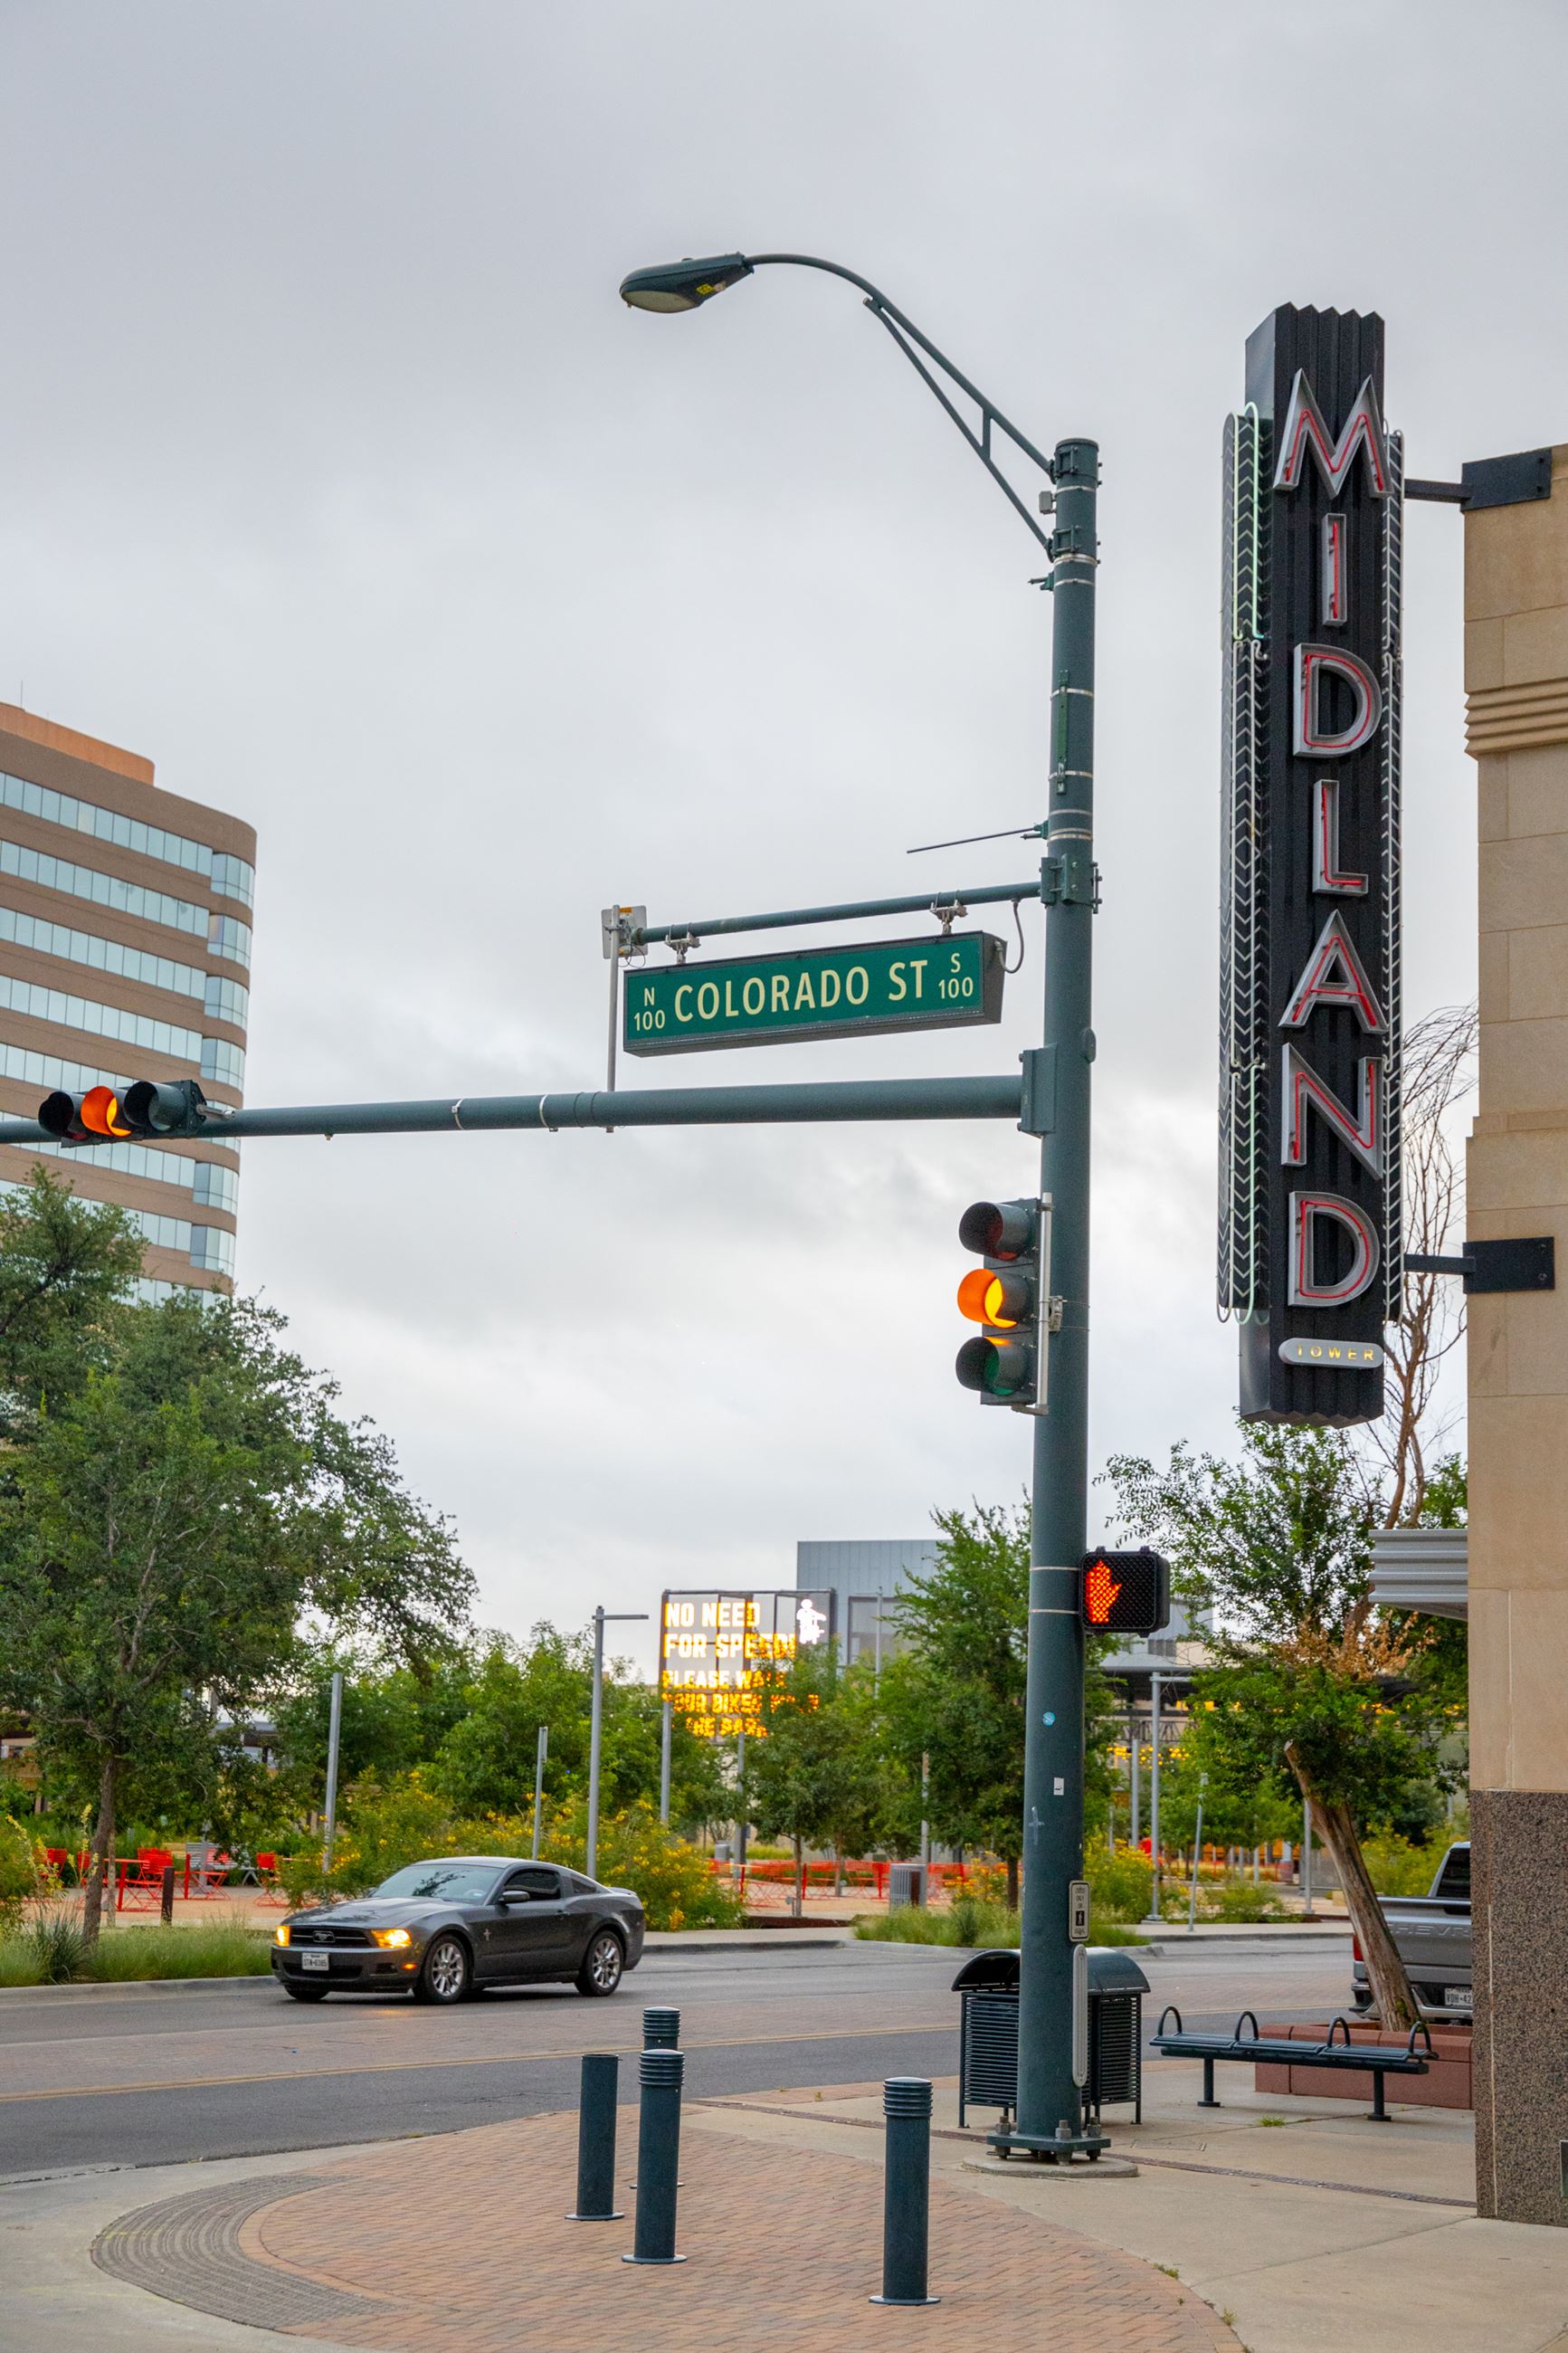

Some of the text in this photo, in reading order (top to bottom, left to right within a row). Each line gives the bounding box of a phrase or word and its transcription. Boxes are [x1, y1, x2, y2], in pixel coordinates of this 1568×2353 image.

[1273, 367, 1394, 1308] MIDLAND
[950, 952, 961, 974] S
[643, 986, 655, 1007] N
[674, 959, 928, 1023] COLORADO ST
[938, 976, 974, 1000] 100
[633, 1009, 666, 1032] 100
[1296, 1344, 1374, 1362] TOWER
[665, 1602, 761, 1628] NO NEED
[663, 1633, 708, 1659] FOR
[662, 1670, 730, 1691] PLEASE
